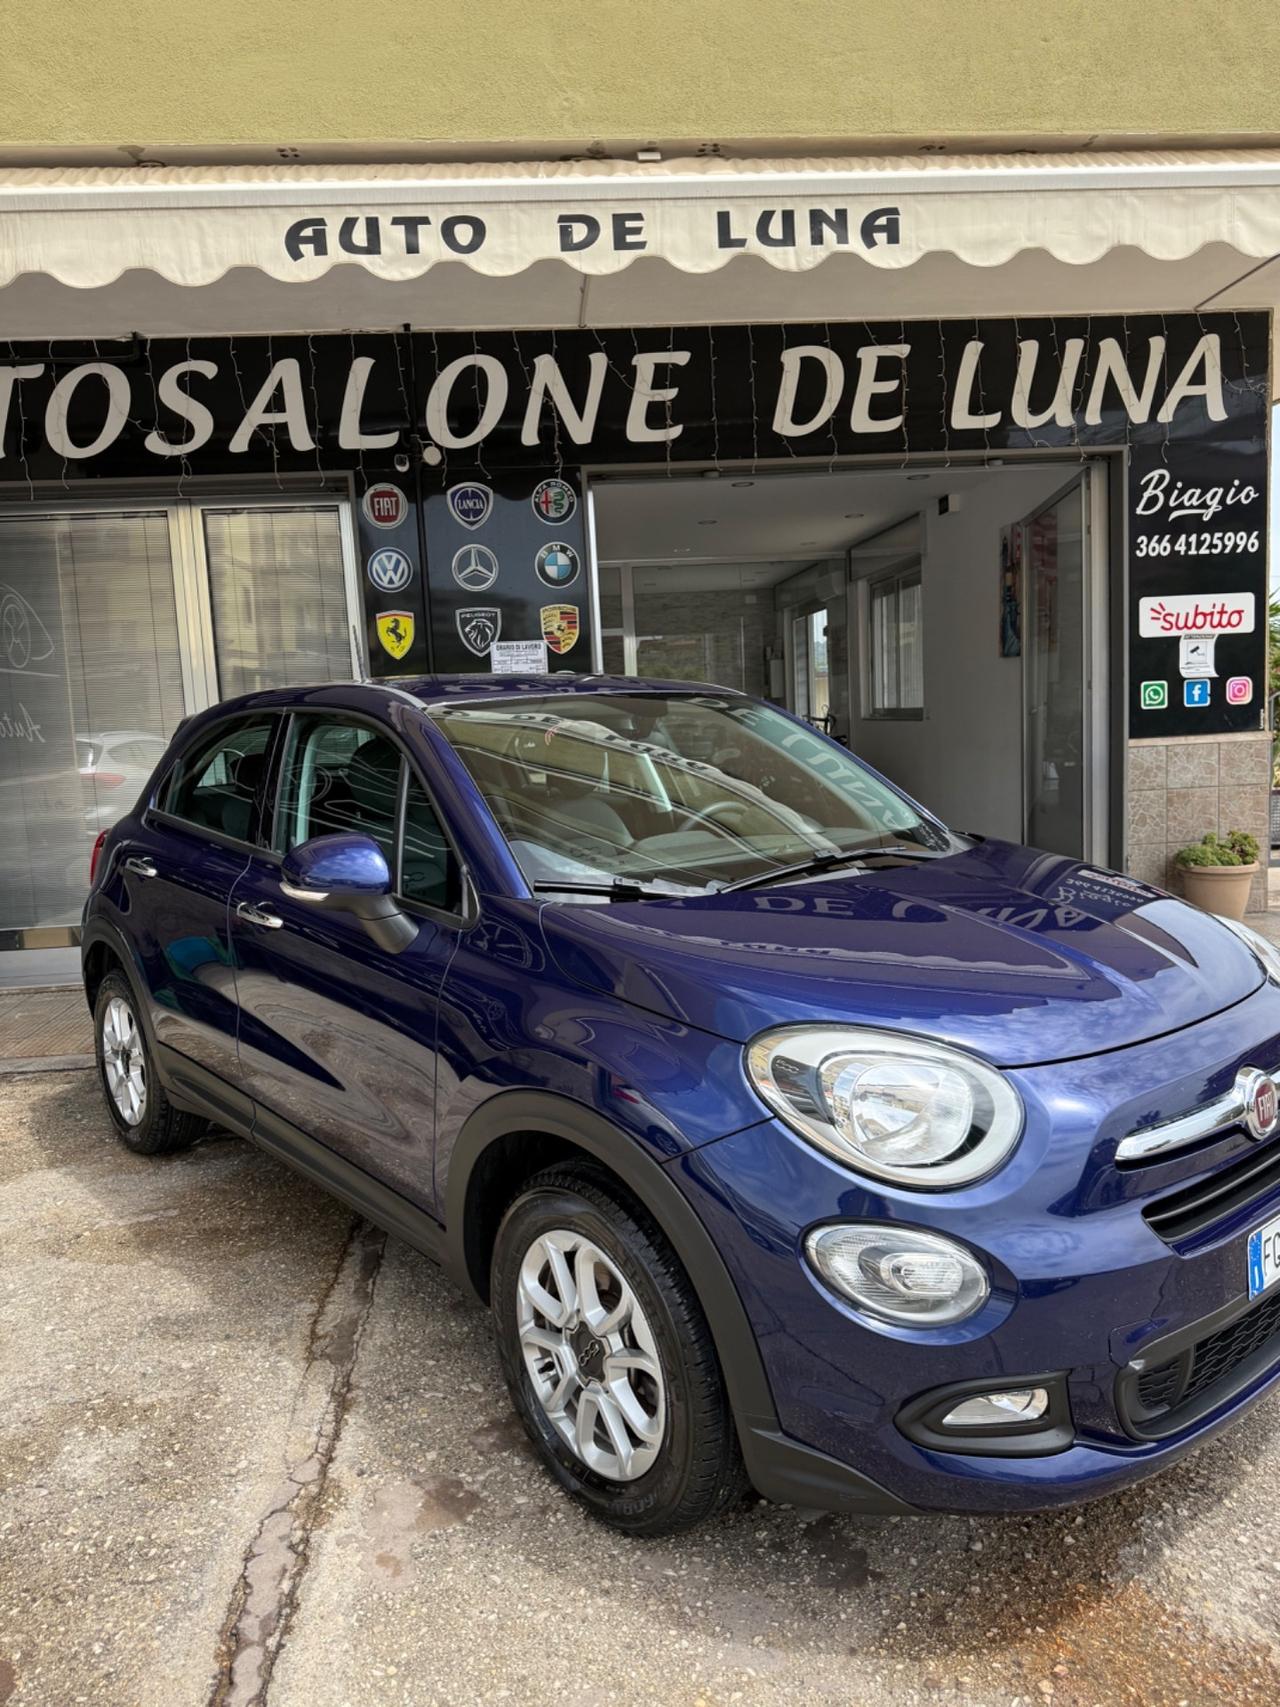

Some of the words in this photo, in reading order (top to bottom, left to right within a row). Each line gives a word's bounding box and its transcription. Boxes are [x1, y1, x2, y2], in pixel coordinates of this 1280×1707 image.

[284, 215, 487, 262] AUTO
[557, 212, 648, 252] DE
[716, 207, 901, 250] LUNA
[772, 343, 911, 437] DE
[950, 333, 1228, 430] LUNA
[373, 497, 398, 517] FIAT
[457, 498, 484, 510] LANCIA
[1135, 469, 1260, 522] Biagio
[540, 544, 576, 559] BMW
[1135, 534, 1171, 557] 366
[1174, 531, 1259, 556] 4125996
[1159, 603, 1245, 631] subito
[1256, 1091, 1273, 1121] FIAT
